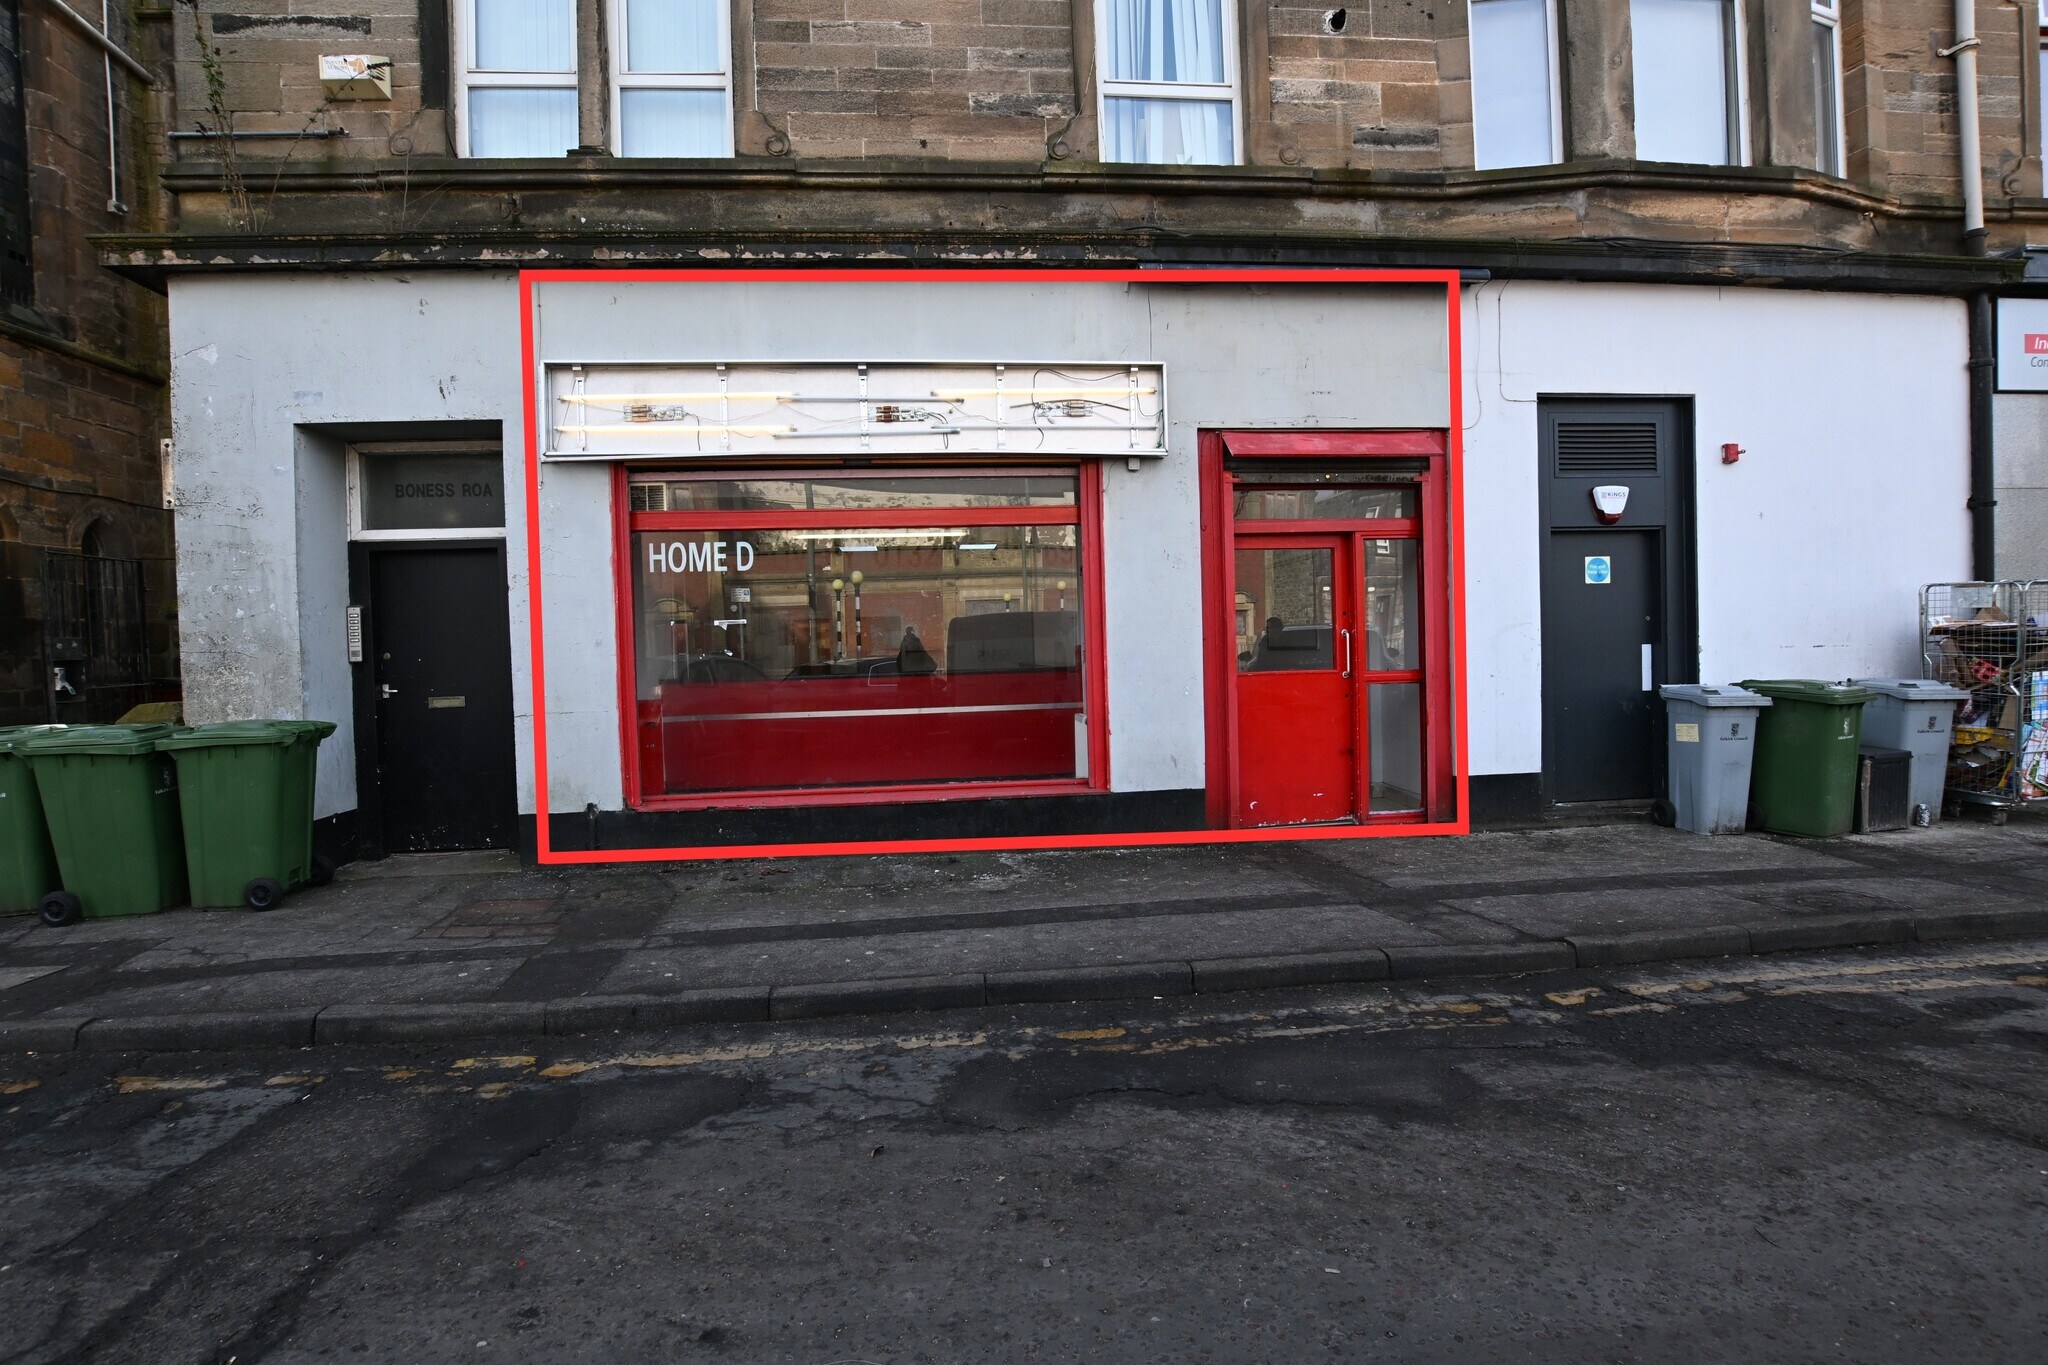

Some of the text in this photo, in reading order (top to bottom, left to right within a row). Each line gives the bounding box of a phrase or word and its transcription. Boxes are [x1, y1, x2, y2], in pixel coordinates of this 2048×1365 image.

[395, 482, 493, 498] BONESS ROA
[648, 541, 754, 573] HOME D
